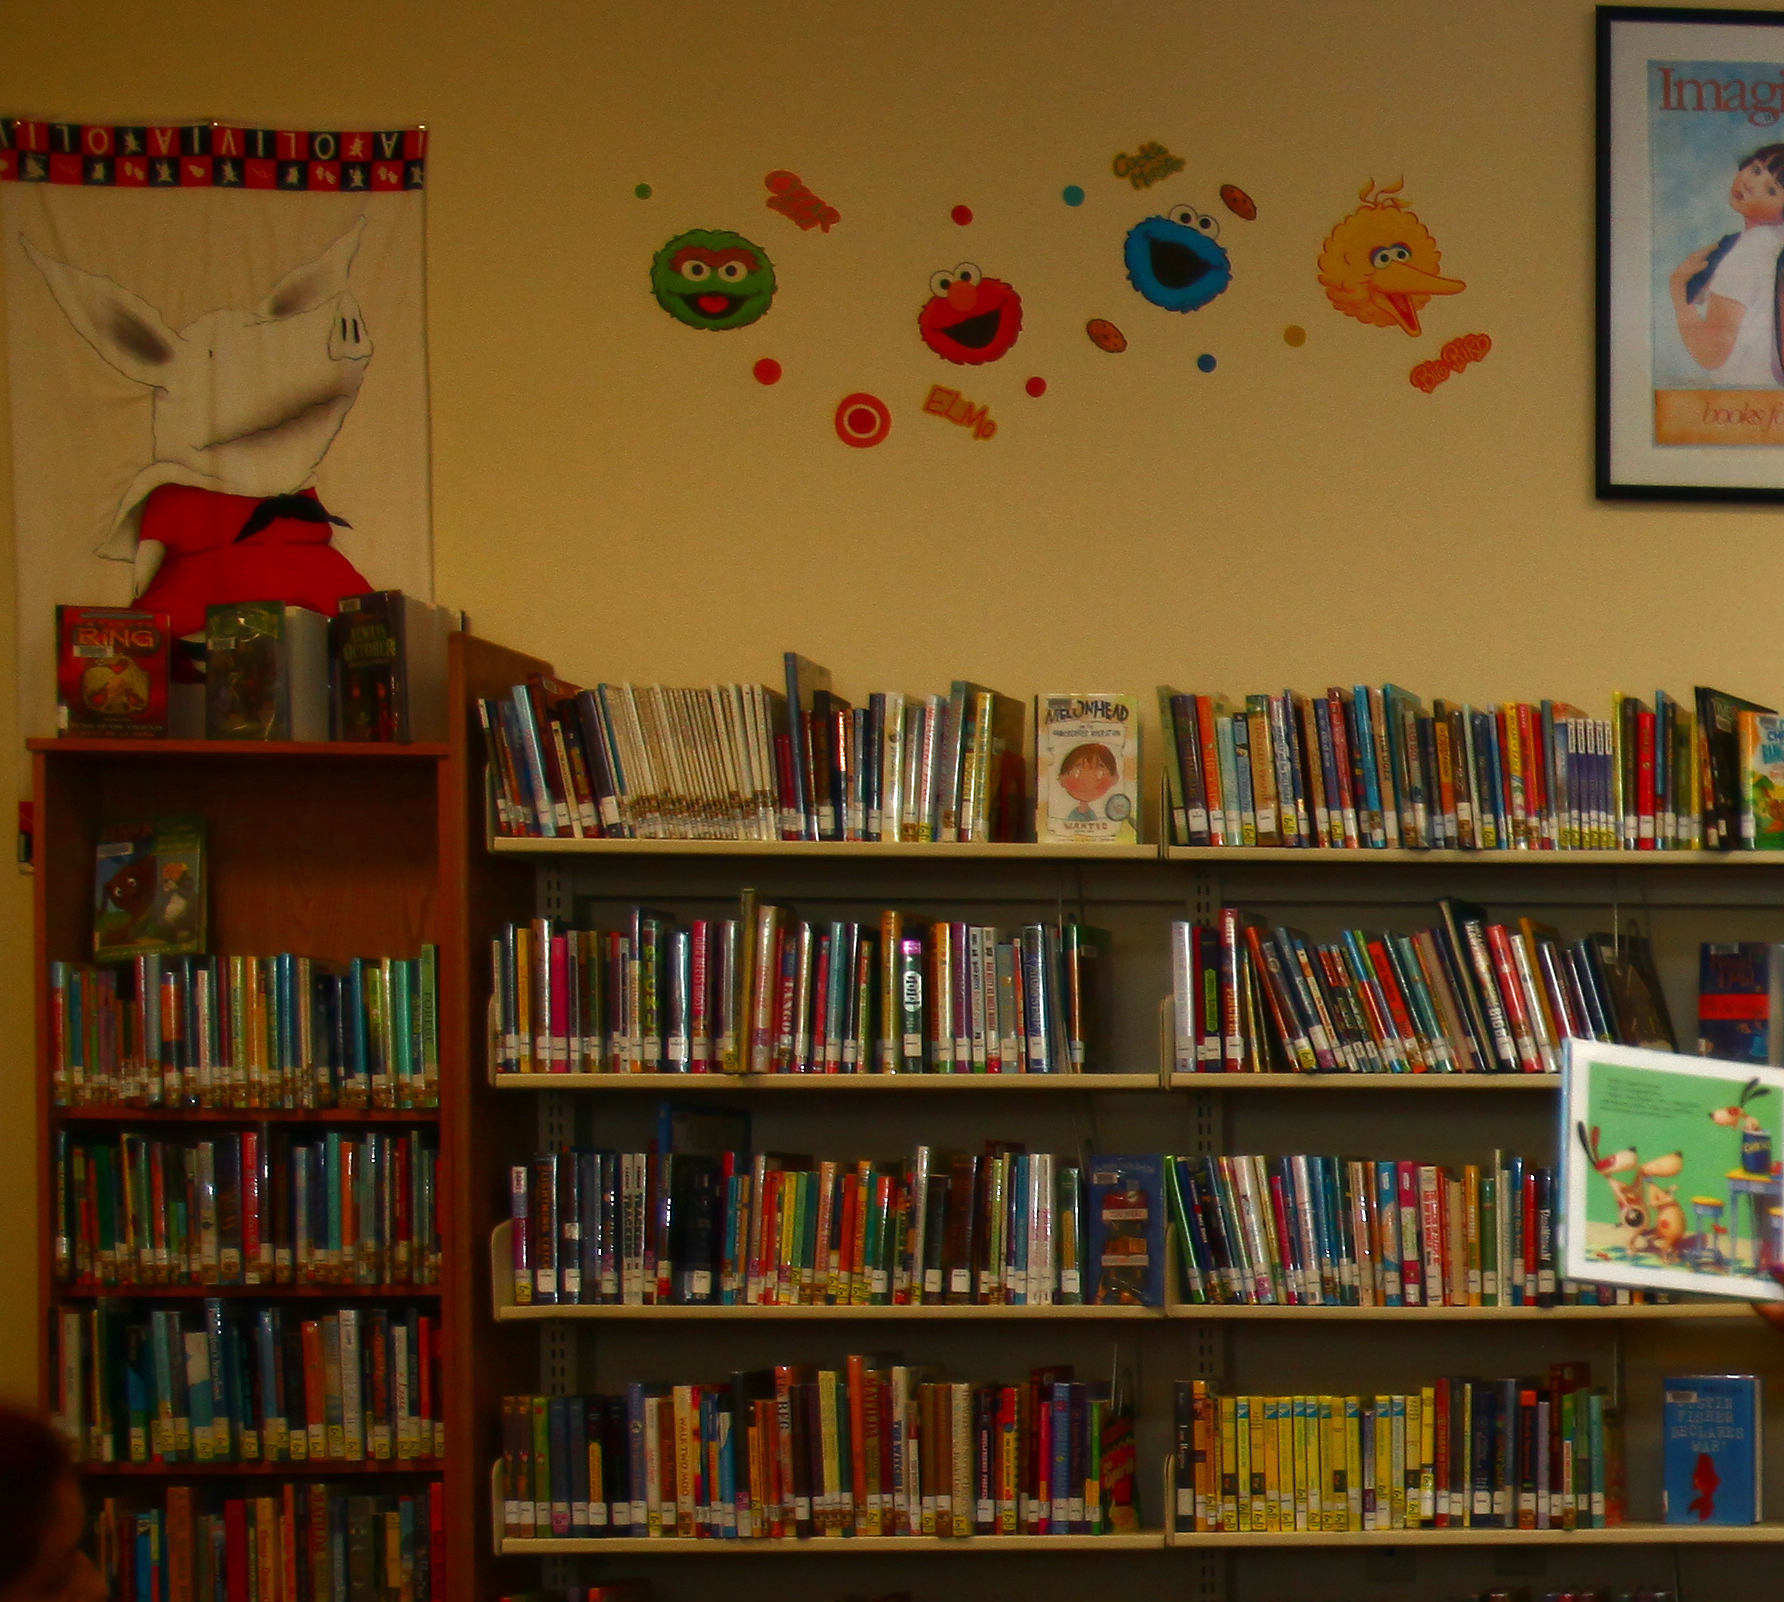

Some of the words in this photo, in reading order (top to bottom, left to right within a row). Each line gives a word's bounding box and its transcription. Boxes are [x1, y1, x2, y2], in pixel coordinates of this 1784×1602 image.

[1701, 402, 1764, 425] books
[694, 958, 705, 983] MEETS
[781, 981, 794, 1032] TANGO
[1226, 988, 1238, 1018] PINCH
[624, 1194, 632, 1258] TRACKERS
[634, 1193, 642, 1258] TRACKERS
[777, 1401, 789, 1430] BFG
[865, 1377, 877, 1439] MATILDA
[1678, 1410, 1734, 1423] FISHER
[679, 1417, 688, 1445] WALK
[1671, 1427, 1745, 1439] DECLARES
[680, 1446, 689, 1470] TWO
[311, 1491, 326, 1553] MATILDA
